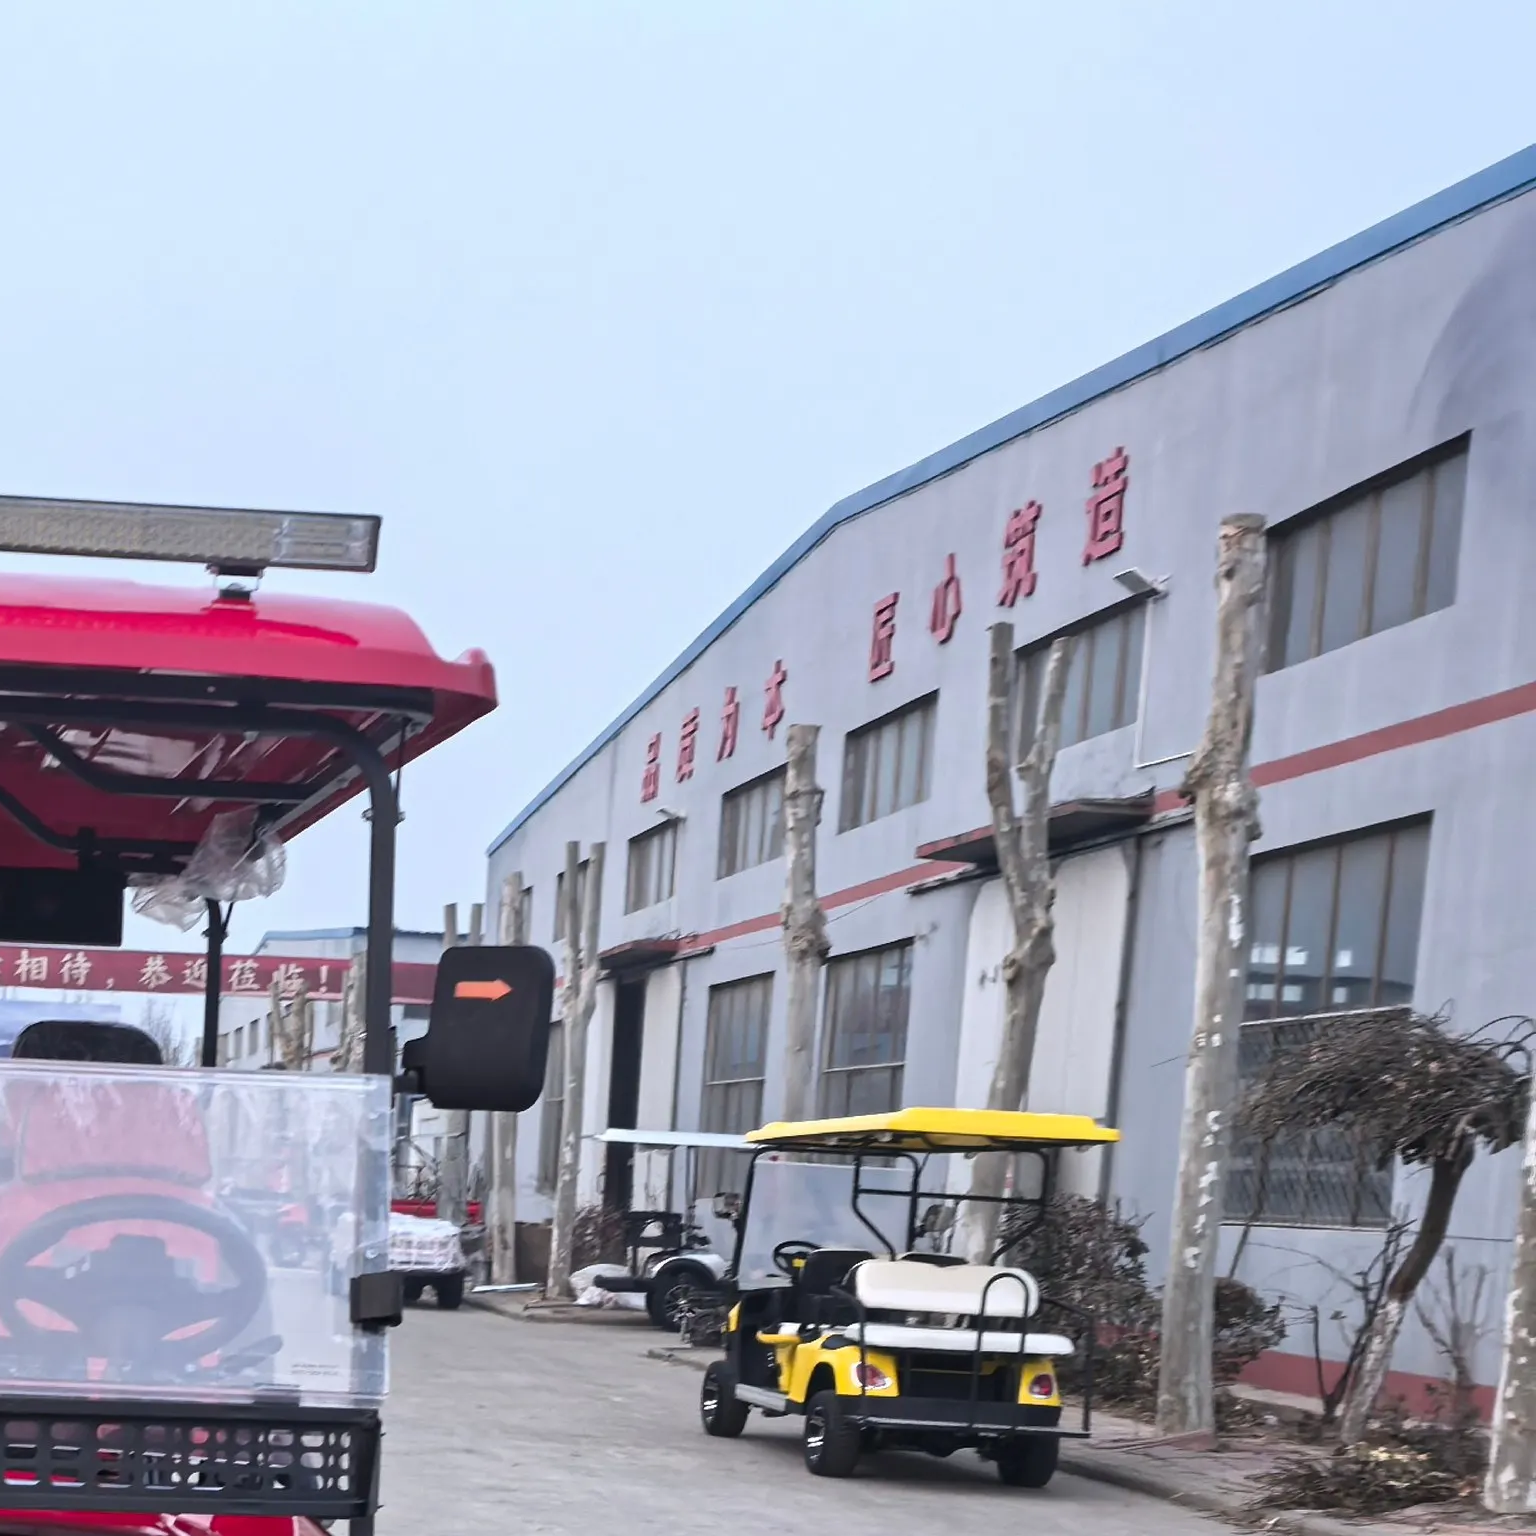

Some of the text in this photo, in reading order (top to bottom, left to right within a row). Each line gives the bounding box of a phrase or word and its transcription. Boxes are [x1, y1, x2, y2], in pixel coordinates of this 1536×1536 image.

[640, 446, 1130, 804] 品质为本 匠心筑造
